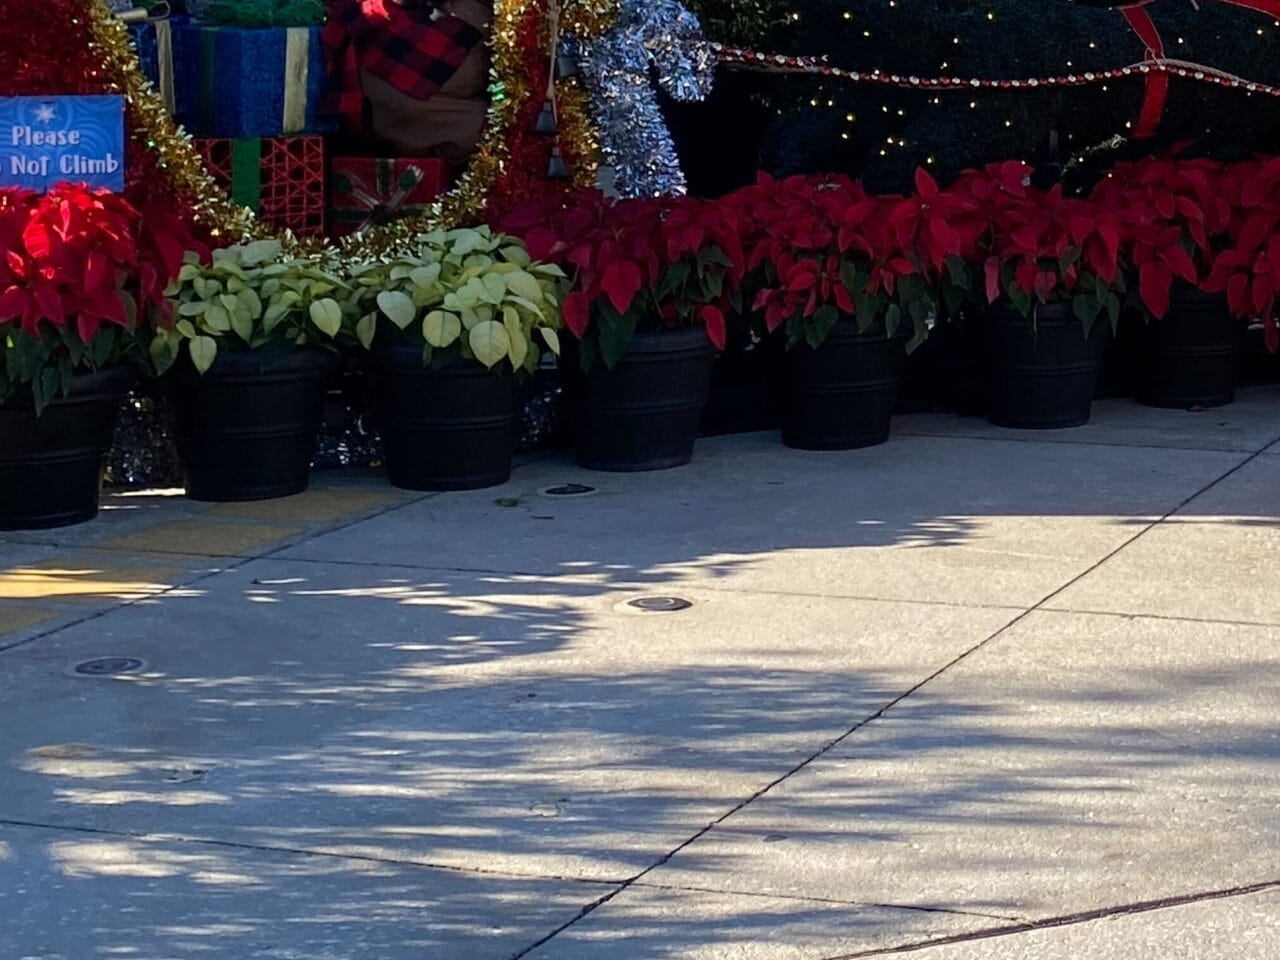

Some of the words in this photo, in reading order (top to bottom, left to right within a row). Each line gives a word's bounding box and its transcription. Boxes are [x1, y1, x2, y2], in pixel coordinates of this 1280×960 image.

[12, 126, 80, 146] Please
[11, 154, 50, 176] Not
[60, 153, 119, 175] Climb
